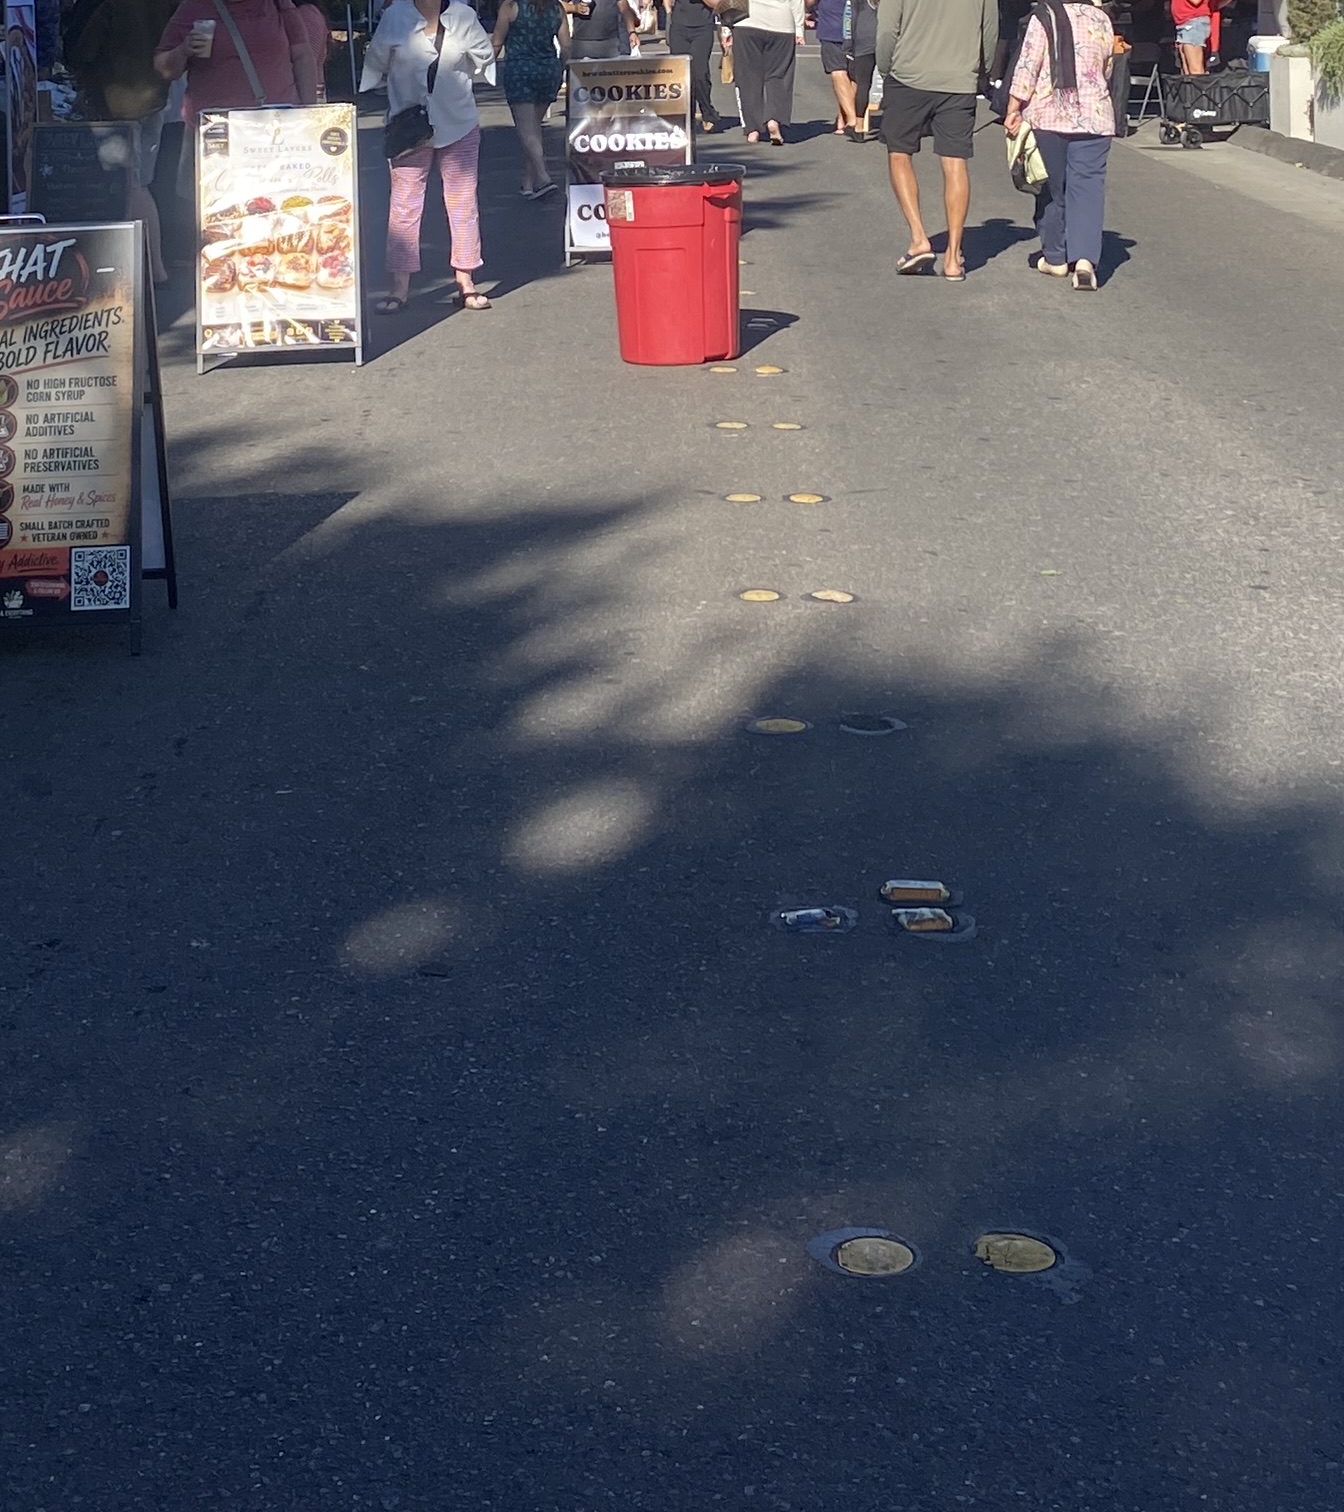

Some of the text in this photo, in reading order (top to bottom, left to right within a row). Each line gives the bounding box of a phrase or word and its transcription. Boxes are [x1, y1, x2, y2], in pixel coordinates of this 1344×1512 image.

[573, 83, 682, 103] COOKIES
[574, 132, 684, 153] COOKIES
[26, 375, 118, 390] NO HIGH FRUCTOSE
[26, 390, 86, 402] CORN SYRUP
[25, 411, 96, 425] NO ARTIFICIAL
[25, 424, 75, 437] ADDITIVES
[24, 446, 96, 461] NO ARTIFICIAL
[23, 459, 100, 473] PRESERVATIVES
[22, 482, 70, 494] MADE WITH
[21, 489, 117, 511] Real Honey & Spices
[19, 518, 110, 532] SMALL BATCH CRAFTED
[31, 530, 98, 543] VETERAN OWNED
